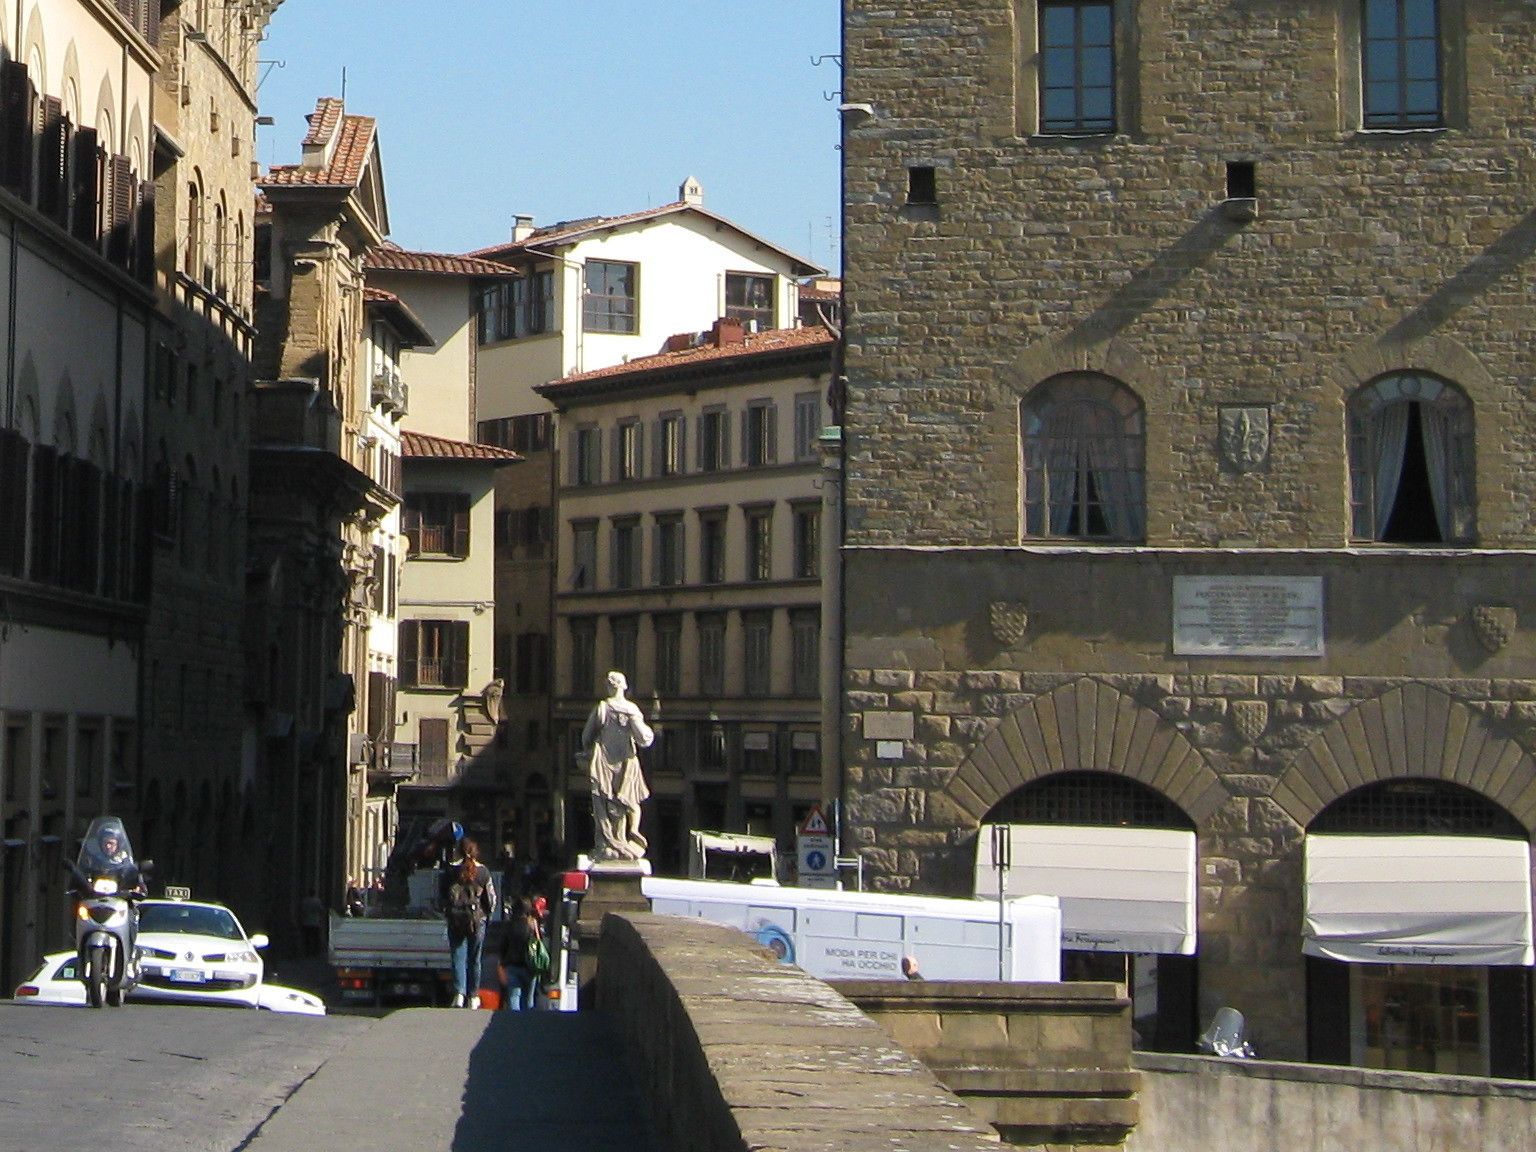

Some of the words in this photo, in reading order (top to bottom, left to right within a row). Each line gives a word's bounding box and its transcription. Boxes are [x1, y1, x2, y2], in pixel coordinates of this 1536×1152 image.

[167, 888, 189, 898] TAXI
[825, 948, 855, 958] MODA
[857, 950, 878, 959] PER
[880, 951, 898, 960] CHI
[842, 959, 855, 967] HA
[857, 960, 898, 971] OCCHIO
